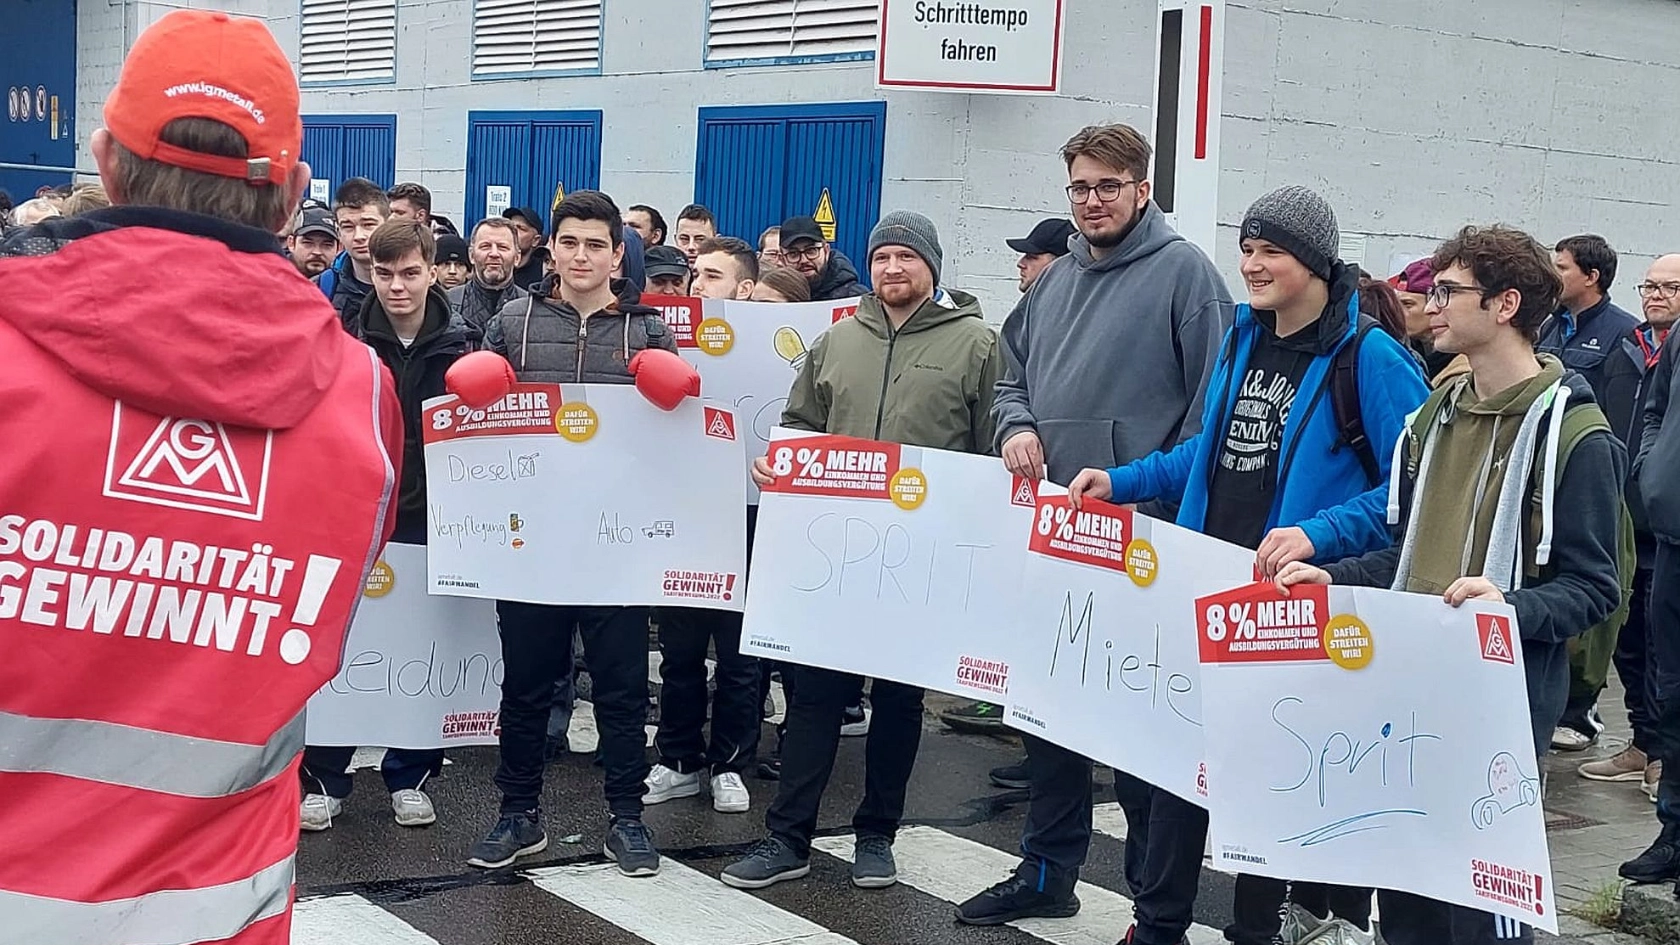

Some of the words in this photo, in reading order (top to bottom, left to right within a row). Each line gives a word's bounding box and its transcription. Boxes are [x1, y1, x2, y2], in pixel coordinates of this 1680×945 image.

[914, 1, 1028, 31] Schritttempo
[941, 38, 997, 61] fahren
[164, 81, 265, 124] www.igmetall.de
[534, 410, 550, 418] UND
[560, 418, 594, 426] STREITEN
[1229, 420, 1273, 441] ENIM
[448, 450, 518, 483] Diesel
[826, 450, 888, 472] MEHR
[870, 473, 887, 481] UND
[430, 503, 508, 549] Verpflegung
[597, 511, 634, 545] Auto
[1075, 511, 1123, 541] MEHR
[0, 513, 295, 598] SOLIDARITÄT
[791, 513, 996, 613] SPRIT
[664, 570, 725, 583] SOLIDARITÄT
[1257, 599, 1316, 627] MEHR
[1257, 628, 1300, 639] EINKOMMEN
[1301, 627, 1318, 637] UND
[1329, 637, 1369, 649] STREITEN
[1333, 625, 1361, 637] DAFÜR
[1228, 637, 1320, 653] AUSBILDUNGSVERGÜTUNG
[959, 656, 1009, 675] SOLIDARITÄT
[1050, 591, 1203, 727] Miete
[957, 666, 1008, 694] GEWINNT
[443, 711, 497, 723] SOLIDARITÄT
[1269, 697, 1442, 807] Sprit
[1471, 859, 1532, 886] SOLIDARITÄT
